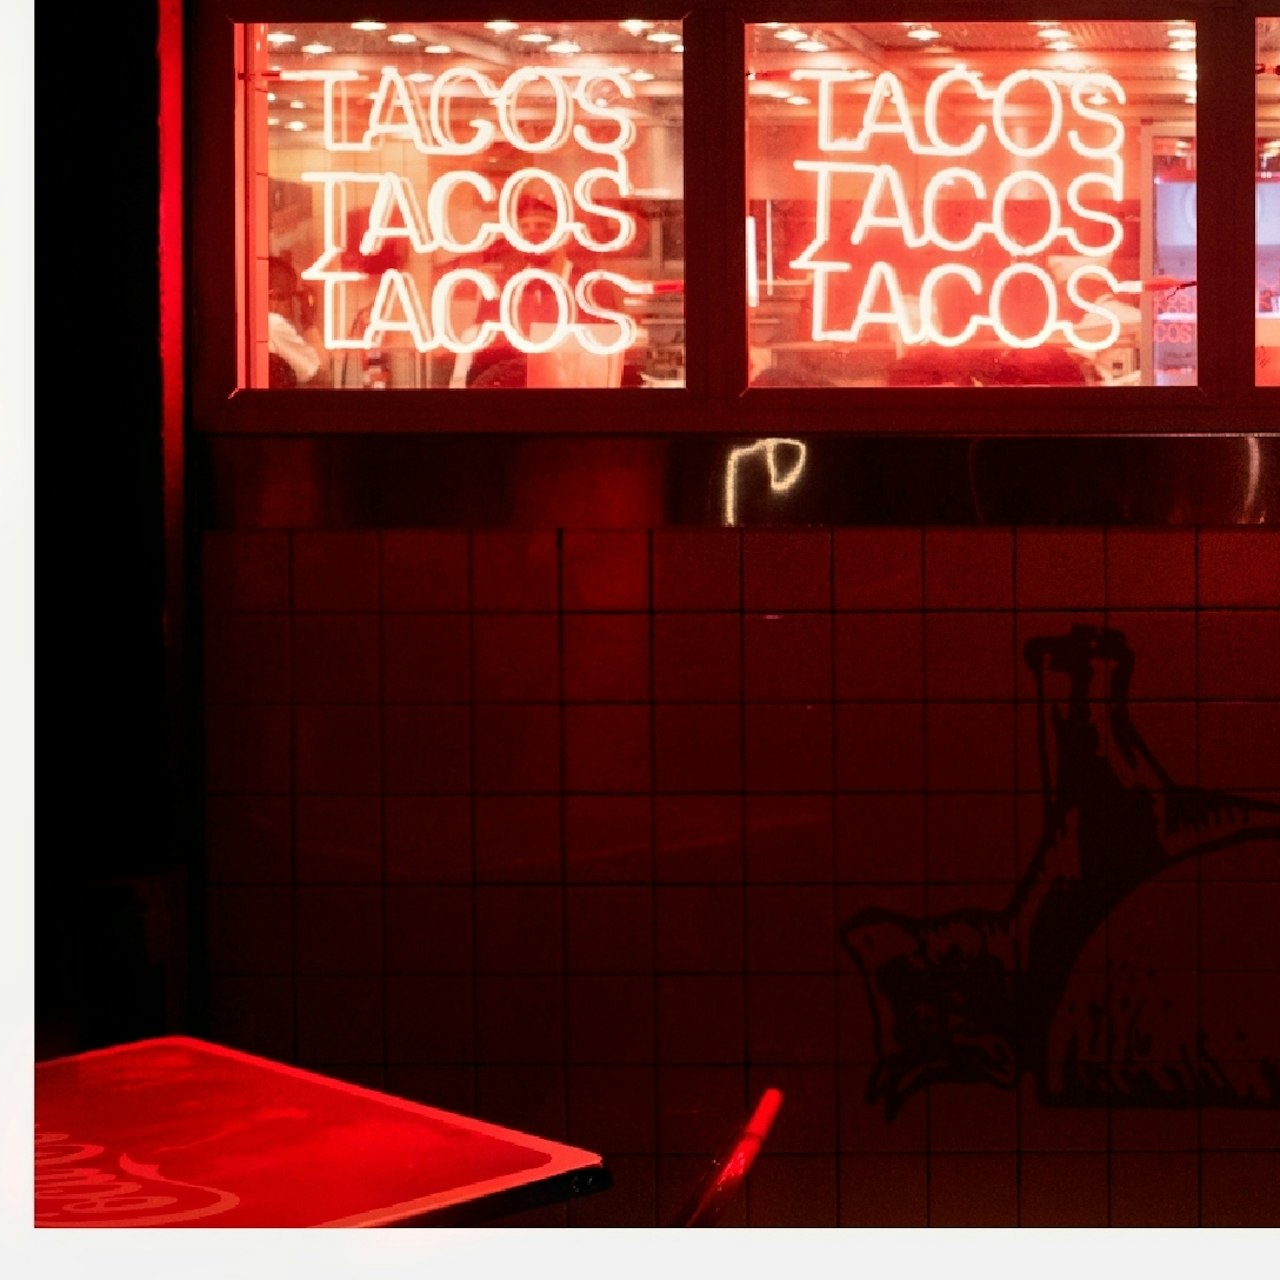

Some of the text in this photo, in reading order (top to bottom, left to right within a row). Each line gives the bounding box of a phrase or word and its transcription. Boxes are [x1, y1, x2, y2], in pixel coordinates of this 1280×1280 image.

[281, 66, 635, 155] TACOS
[792, 69, 1125, 157] TACOS
[301, 168, 635, 255] TACOS
[793, 160, 1123, 257] TACOS
[301, 268, 652, 355] TACOS
[790, 261, 1142, 350] TACOS
